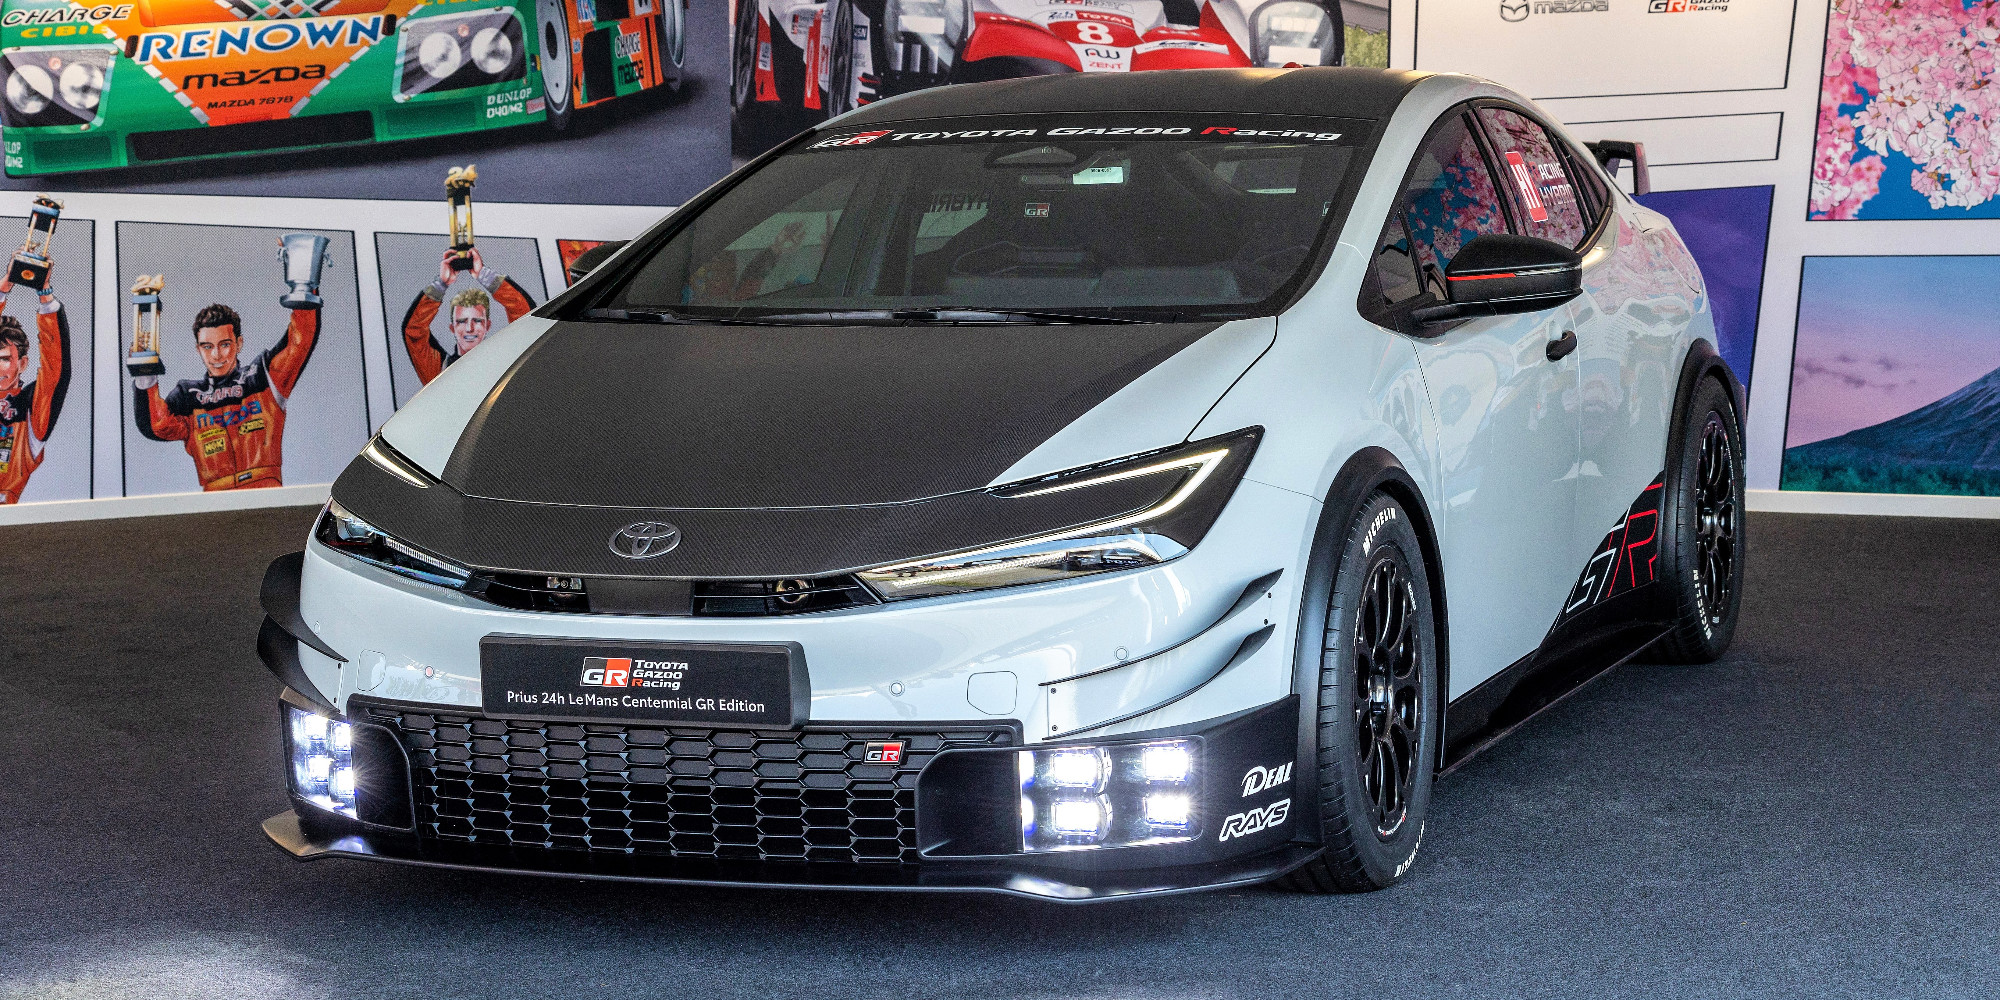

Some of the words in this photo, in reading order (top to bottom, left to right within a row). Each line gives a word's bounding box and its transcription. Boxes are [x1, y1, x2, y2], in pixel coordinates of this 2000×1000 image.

[1649, 0, 1686, 13] GR
[1, 5, 132, 27] CHARGE
[1079, 12, 1132, 26] TOTAL
[136, 15, 384, 64] RENOWN
[1077, 22, 1114, 44] 8
[1089, 61, 1123, 70] ZENT
[182, 64, 326, 90] mazda
[207, 98, 255, 109] MAZDA
[487, 87, 532, 105] DUNLOP
[892, 128, 1037, 141] TOYOTA
[1047, 126, 1192, 136] GAZOO
[1200, 126, 1342, 141] Racing
[1528, 161, 1566, 181] RACING
[1539, 183, 1577, 208] HYBRID
[1025, 207, 1049, 217] GR
[196, 400, 263, 429] mazda
[1362, 507, 1396, 557] MICHELIN
[633, 669, 683, 679] GAZOO
[634, 660, 688, 670] TOYOTA
[582, 668, 627, 686] GR
[631, 678, 680, 690] Racing
[507, 691, 538, 704] Prius
[541, 692, 565, 705] 24h
[622, 695, 692, 710] Centennial
[696, 698, 715, 710] GR
[719, 699, 765, 712] Edition
[866, 750, 898, 761] GR
[1240, 761, 1293, 797] IDEAL
[1219, 797, 1291, 842] RAYS
